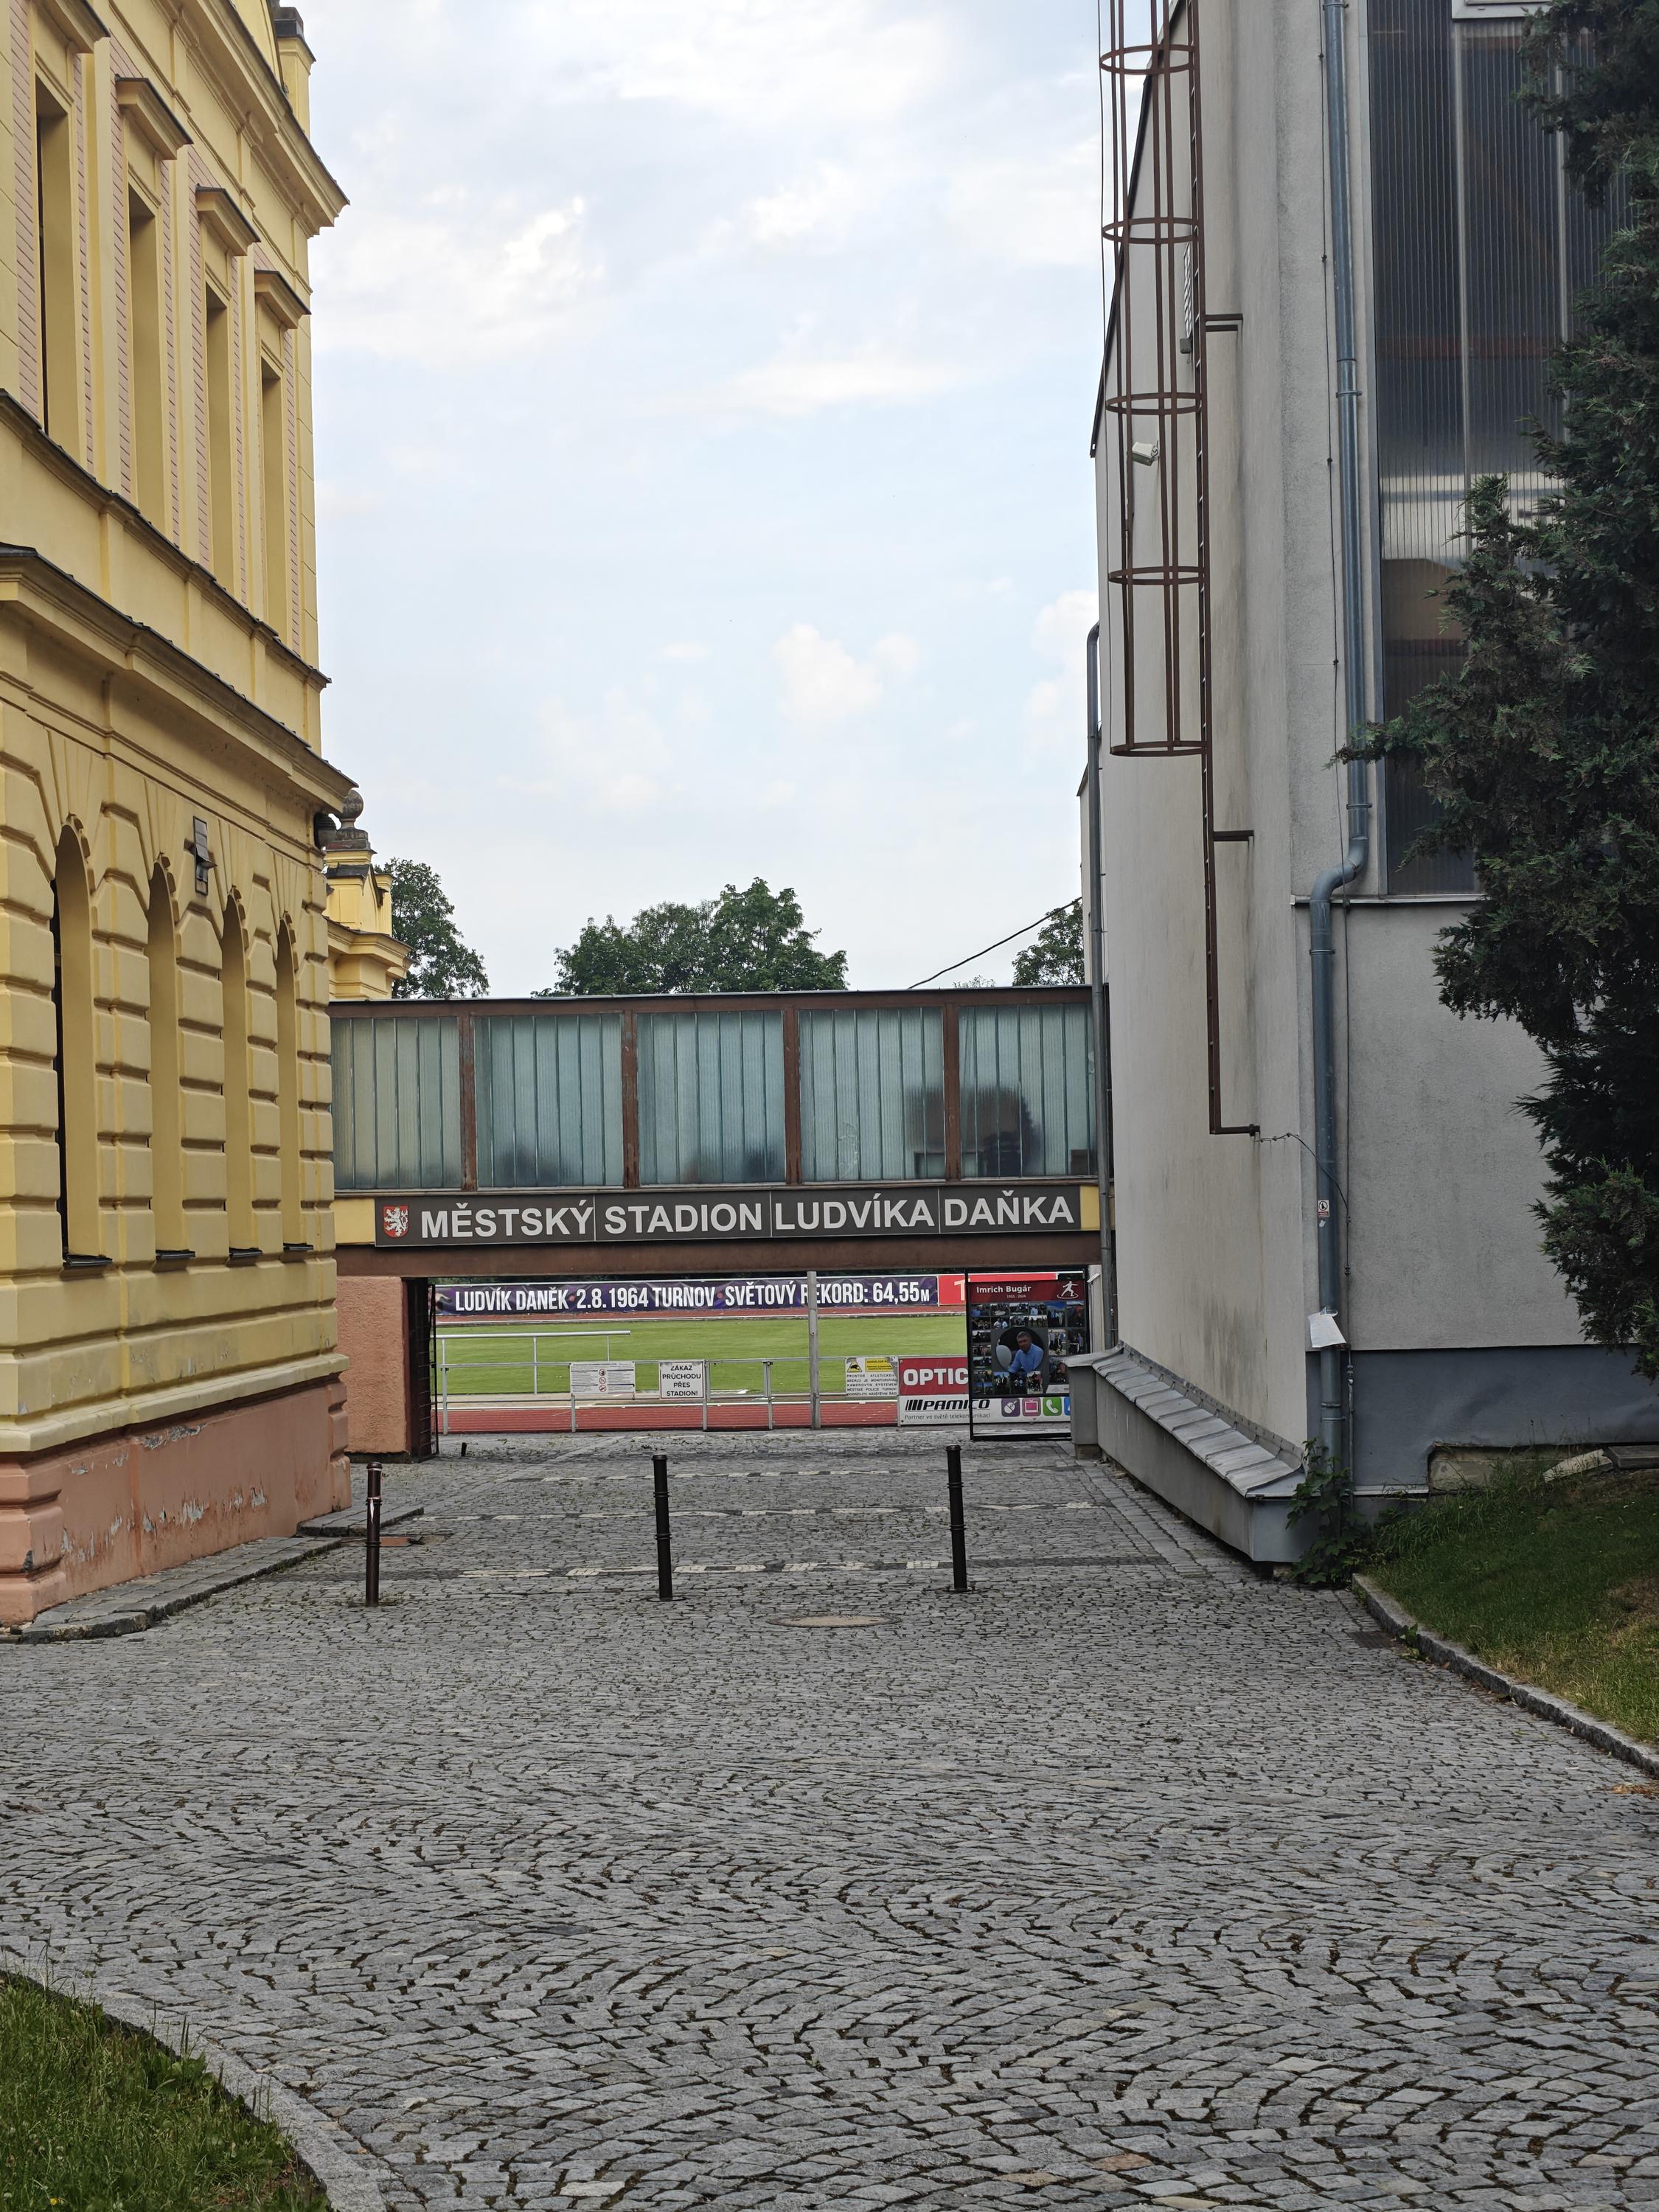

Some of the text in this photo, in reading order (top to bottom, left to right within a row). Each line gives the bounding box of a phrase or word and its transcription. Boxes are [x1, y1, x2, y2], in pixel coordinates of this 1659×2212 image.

[421, 1190, 1074, 1239] MĚSTSKÝ STADION LUDVÍKA DAŇKA
[455, 1287, 512, 1311] LUDVÍK
[516, 1287, 569, 1310] DANĚK
[653, 1286, 715, 1307] TURNOV
[725, 1280, 796, 1305] SVĚTOVÝ
[1006, 1285, 1032, 1293] Bugár
